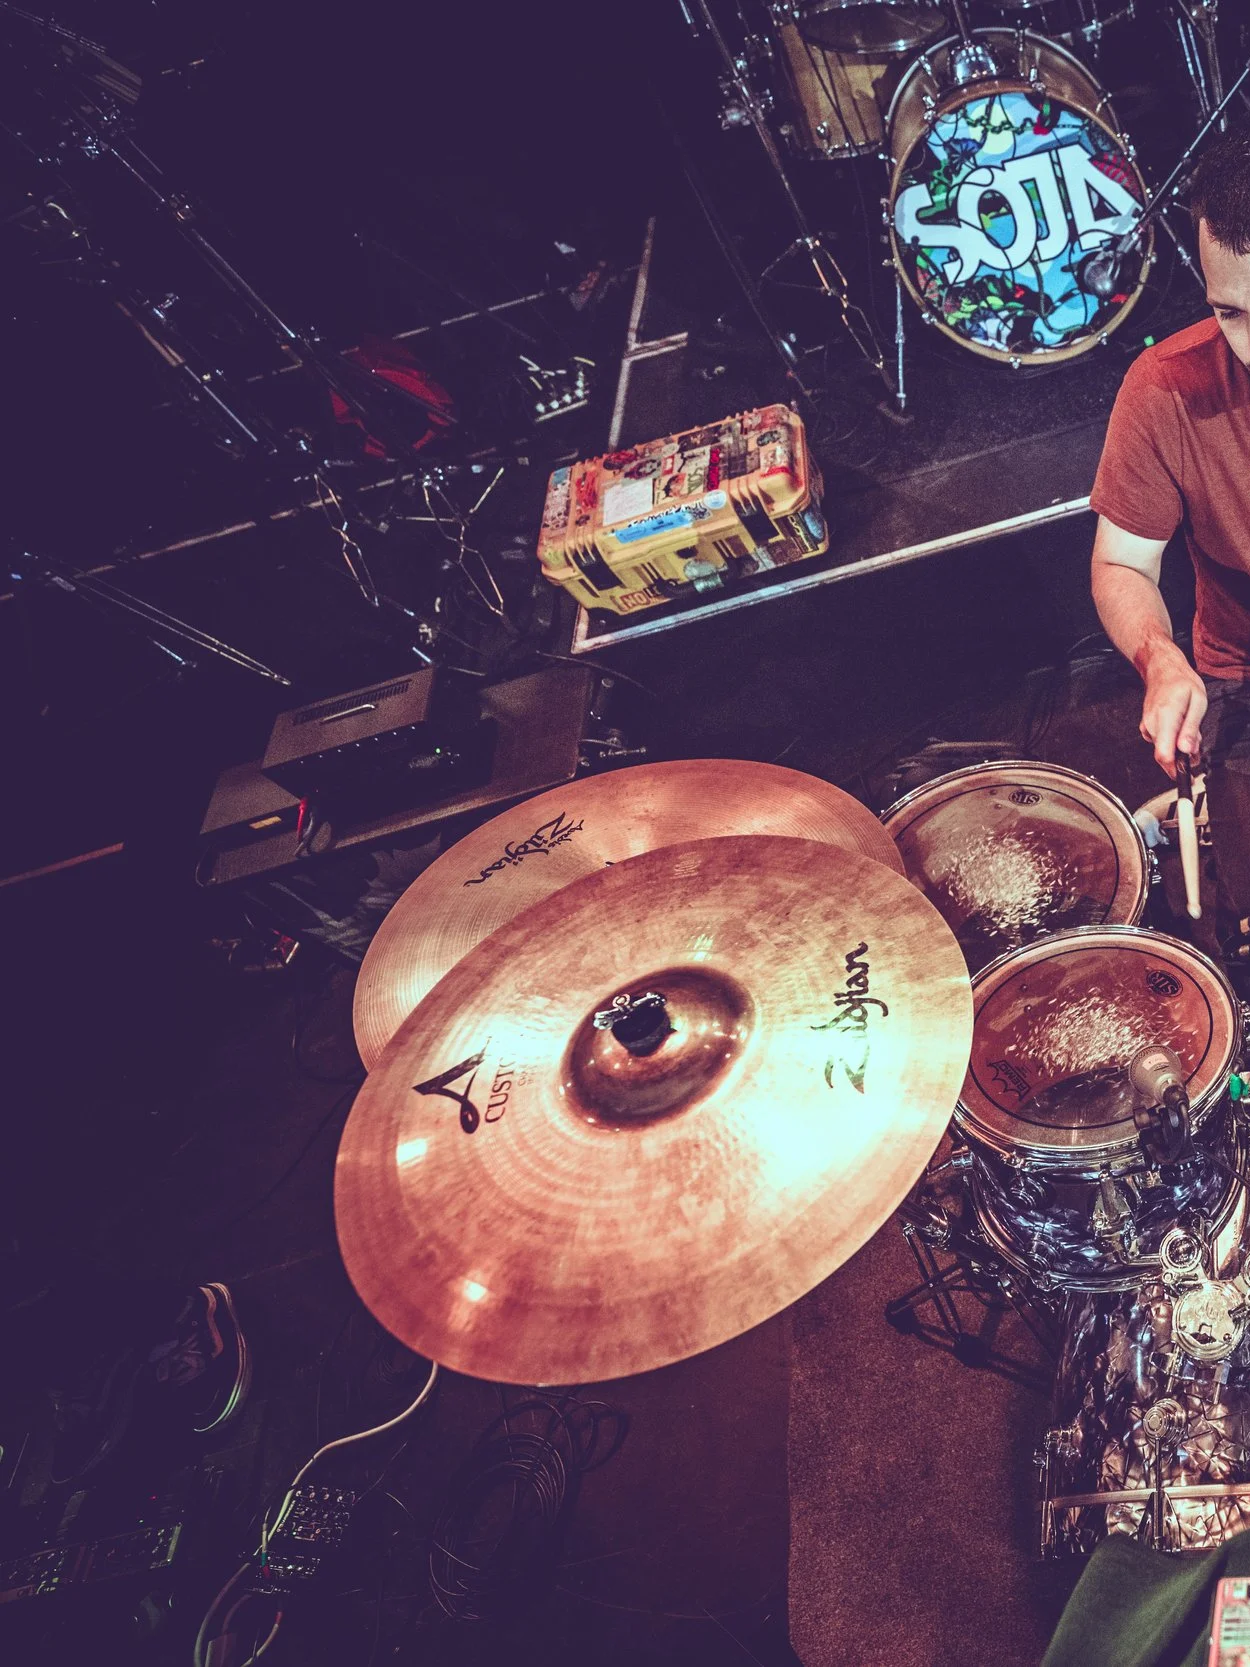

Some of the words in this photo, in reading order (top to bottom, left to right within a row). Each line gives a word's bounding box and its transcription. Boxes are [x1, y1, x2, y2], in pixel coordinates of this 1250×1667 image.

[895, 144, 1143, 285] SOJA
[463, 812, 574, 887] Zildjian
[485, 1057, 516, 1123] CUST
[1000, 1062, 1028, 1092] REMO
